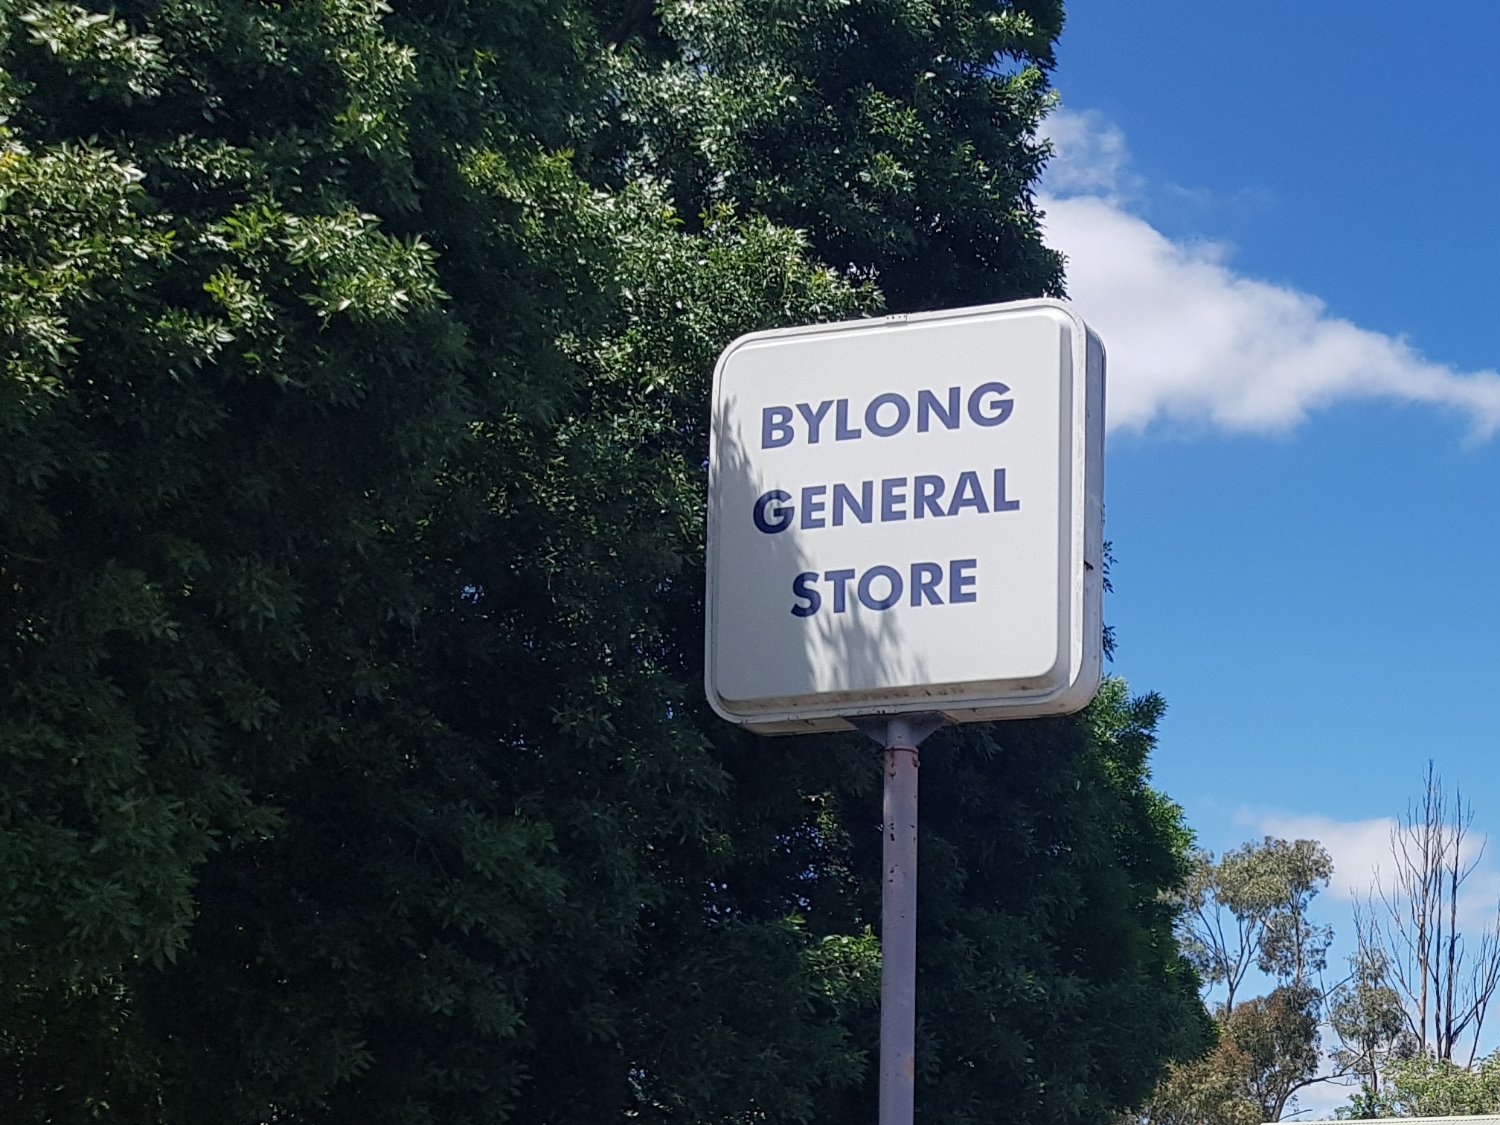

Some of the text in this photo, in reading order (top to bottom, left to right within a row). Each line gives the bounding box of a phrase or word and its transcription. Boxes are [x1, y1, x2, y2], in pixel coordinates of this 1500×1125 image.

[761, 381, 1015, 450] BYLONG
[752, 467, 1021, 535] GENERAL
[790, 558, 978, 618] STORE
